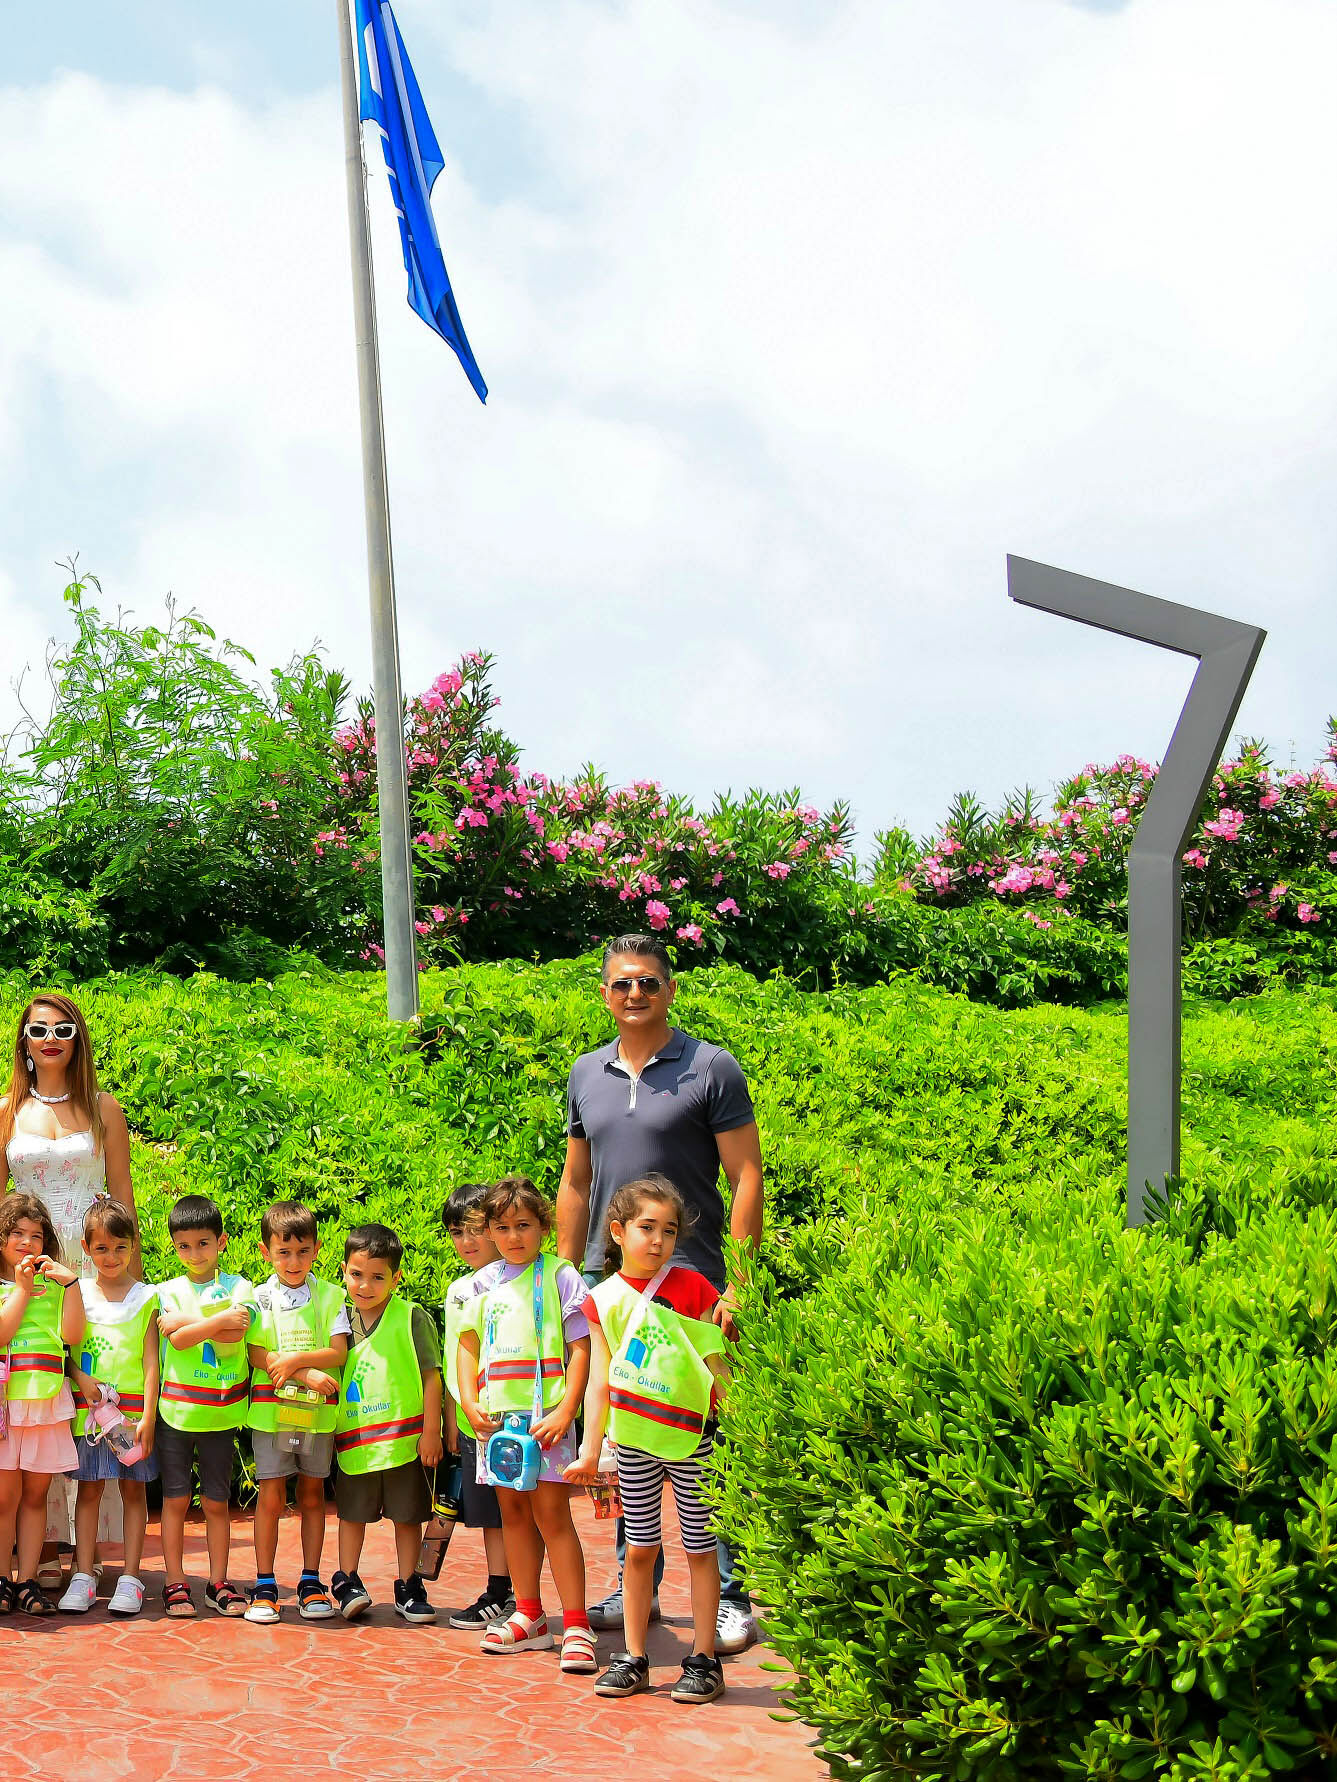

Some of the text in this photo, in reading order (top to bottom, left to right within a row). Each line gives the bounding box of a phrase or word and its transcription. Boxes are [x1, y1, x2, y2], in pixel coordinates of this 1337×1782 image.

[614, 1366, 630, 1379] Eko
[637, 1375, 671, 1393] Okullar
[361, 1401, 391, 1414] Okullar
